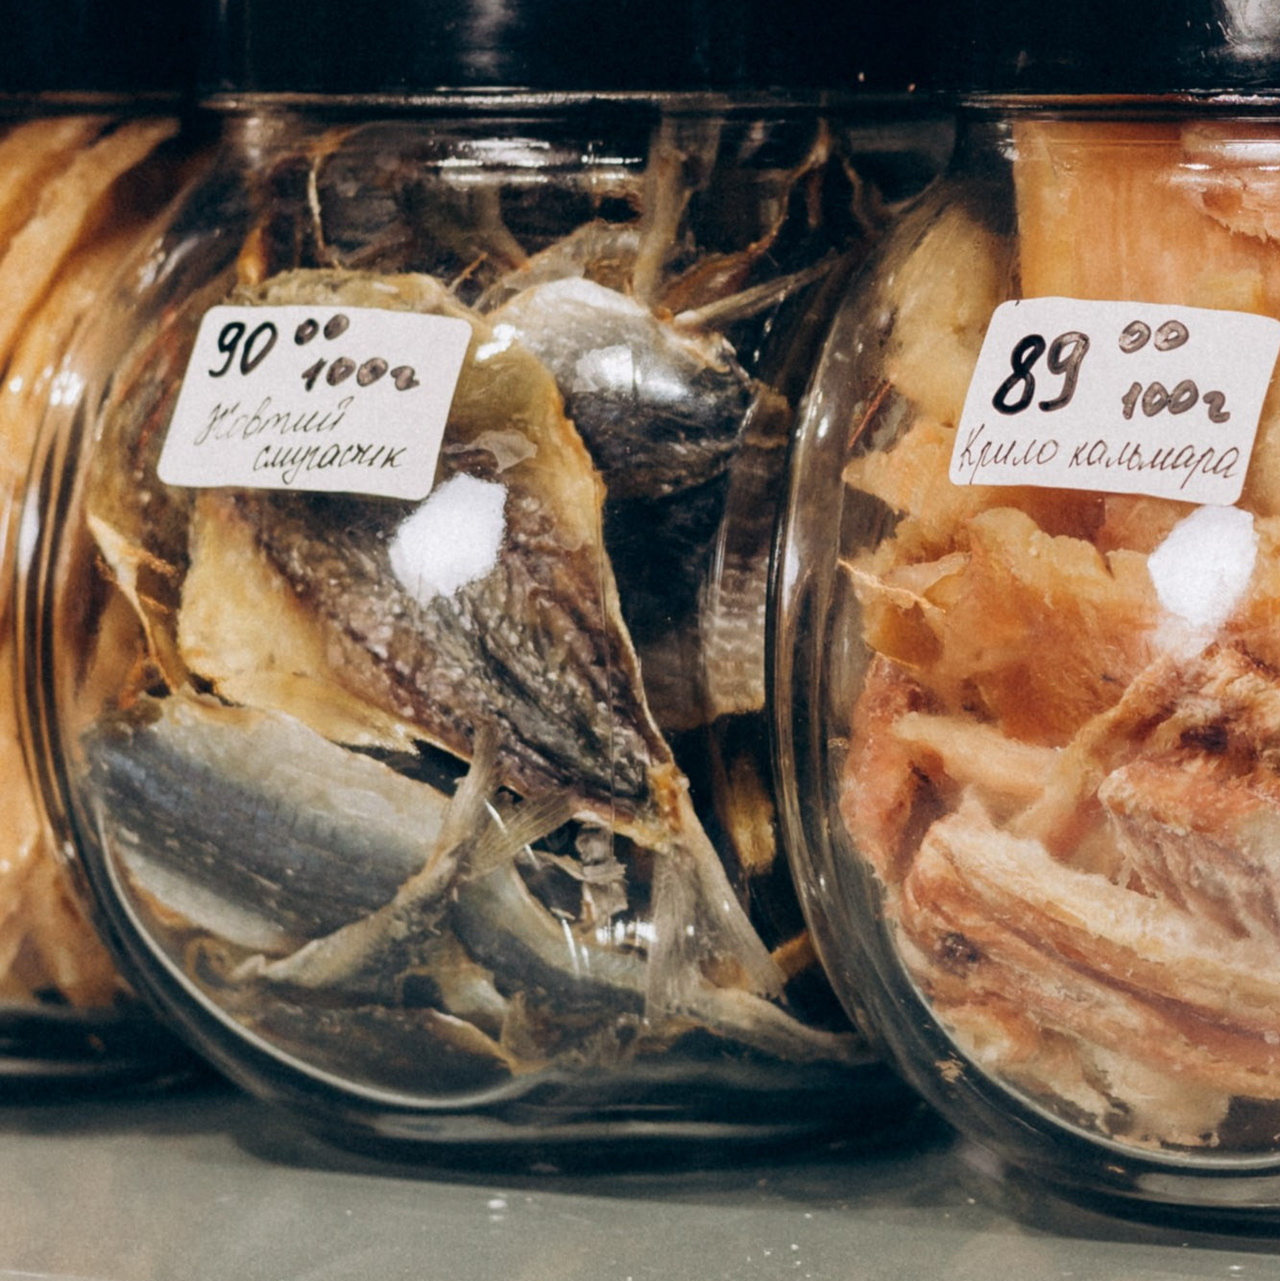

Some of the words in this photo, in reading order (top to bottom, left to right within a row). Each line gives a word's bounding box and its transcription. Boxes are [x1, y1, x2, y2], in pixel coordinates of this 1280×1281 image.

[209, 322, 277, 377] 90
[992, 331, 1090, 415] 89
[1118, 320, 1190, 353] 00
[959, 424, 1059, 484] Крило
[1069, 439, 1240, 489] кальмара
